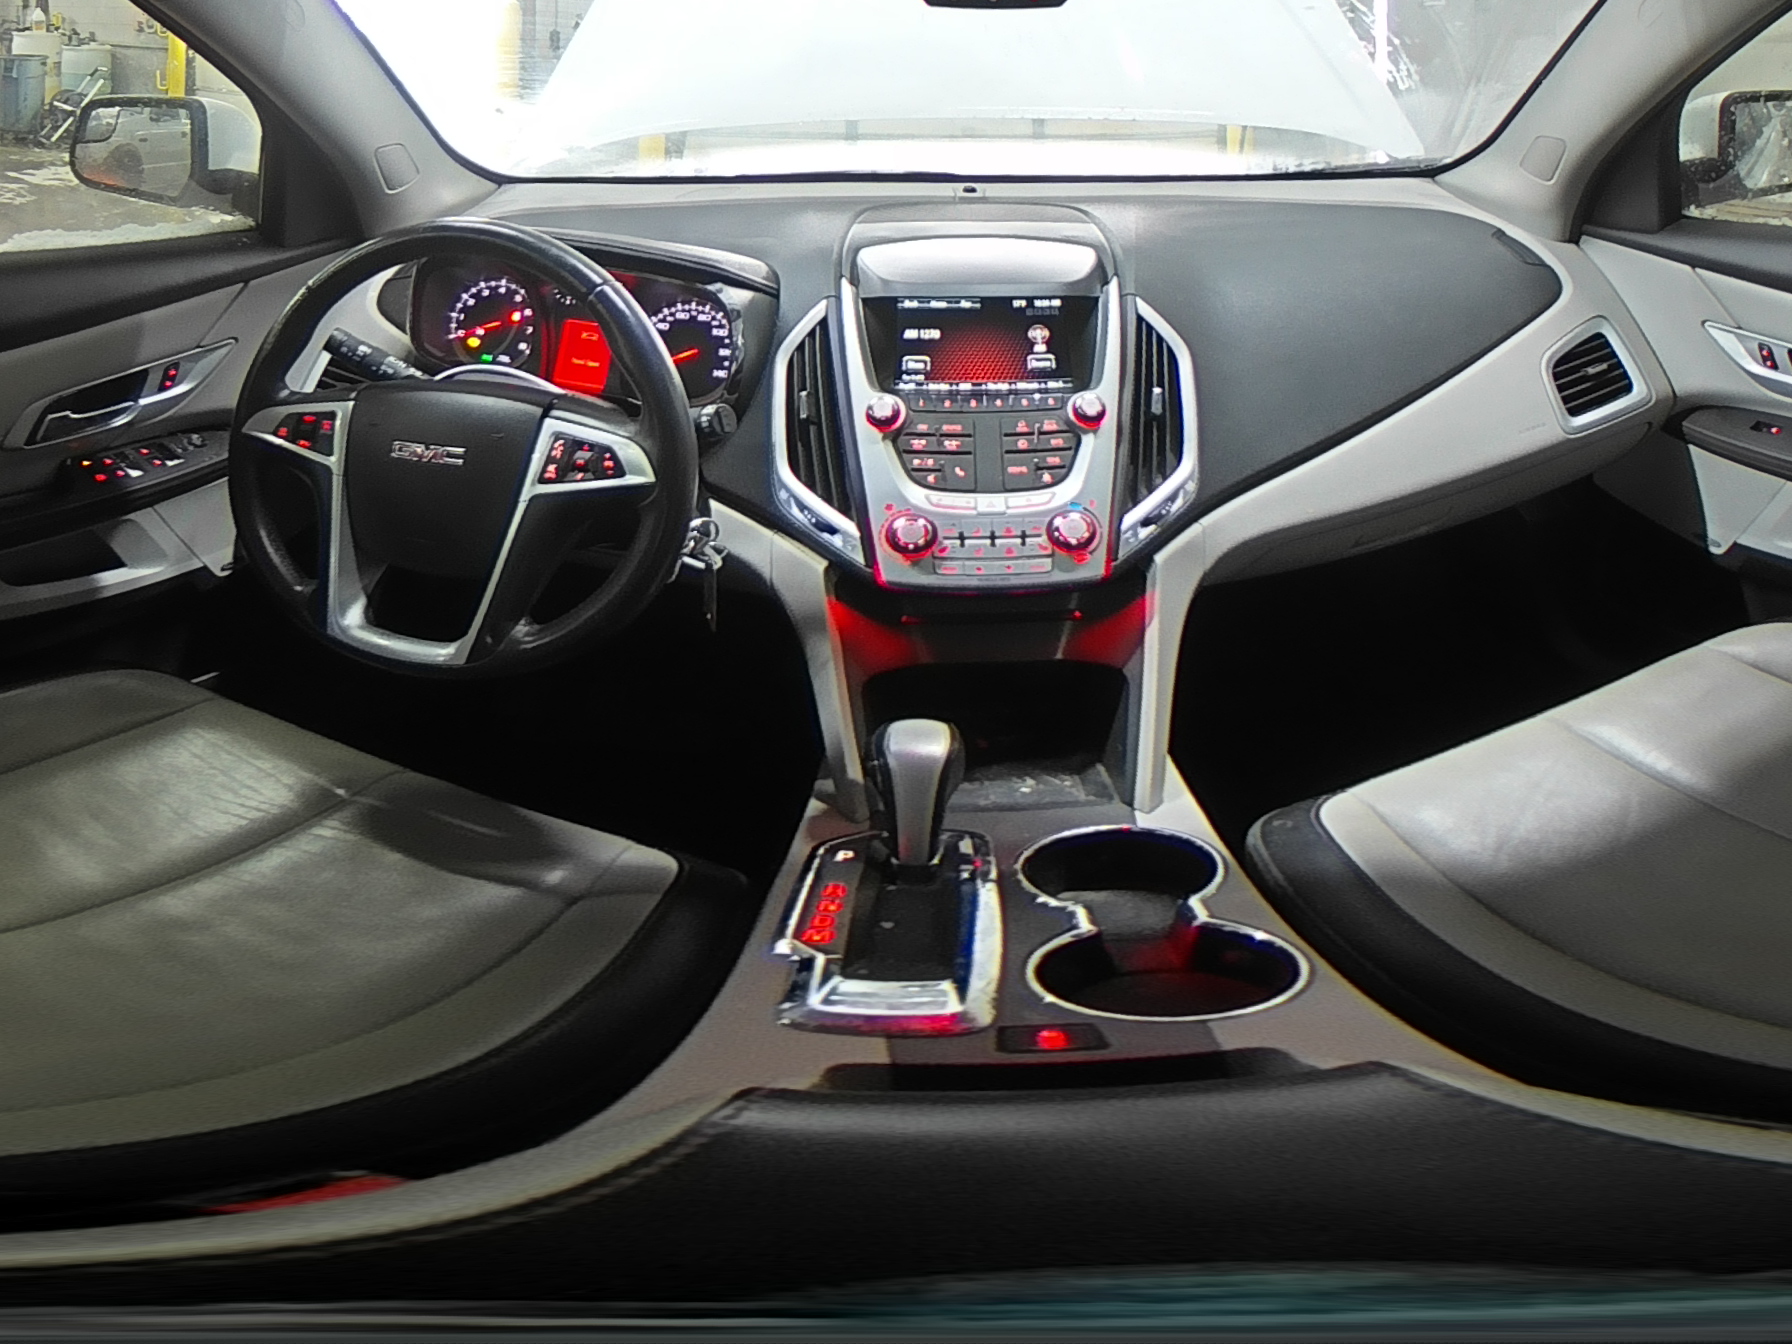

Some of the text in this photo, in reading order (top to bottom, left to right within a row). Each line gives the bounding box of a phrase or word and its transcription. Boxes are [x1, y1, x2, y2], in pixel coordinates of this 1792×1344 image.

[390, 440, 468, 467] GMC
[833, 850, 855, 862] P
[811, 914, 836, 928] D
[801, 929, 836, 943] M
